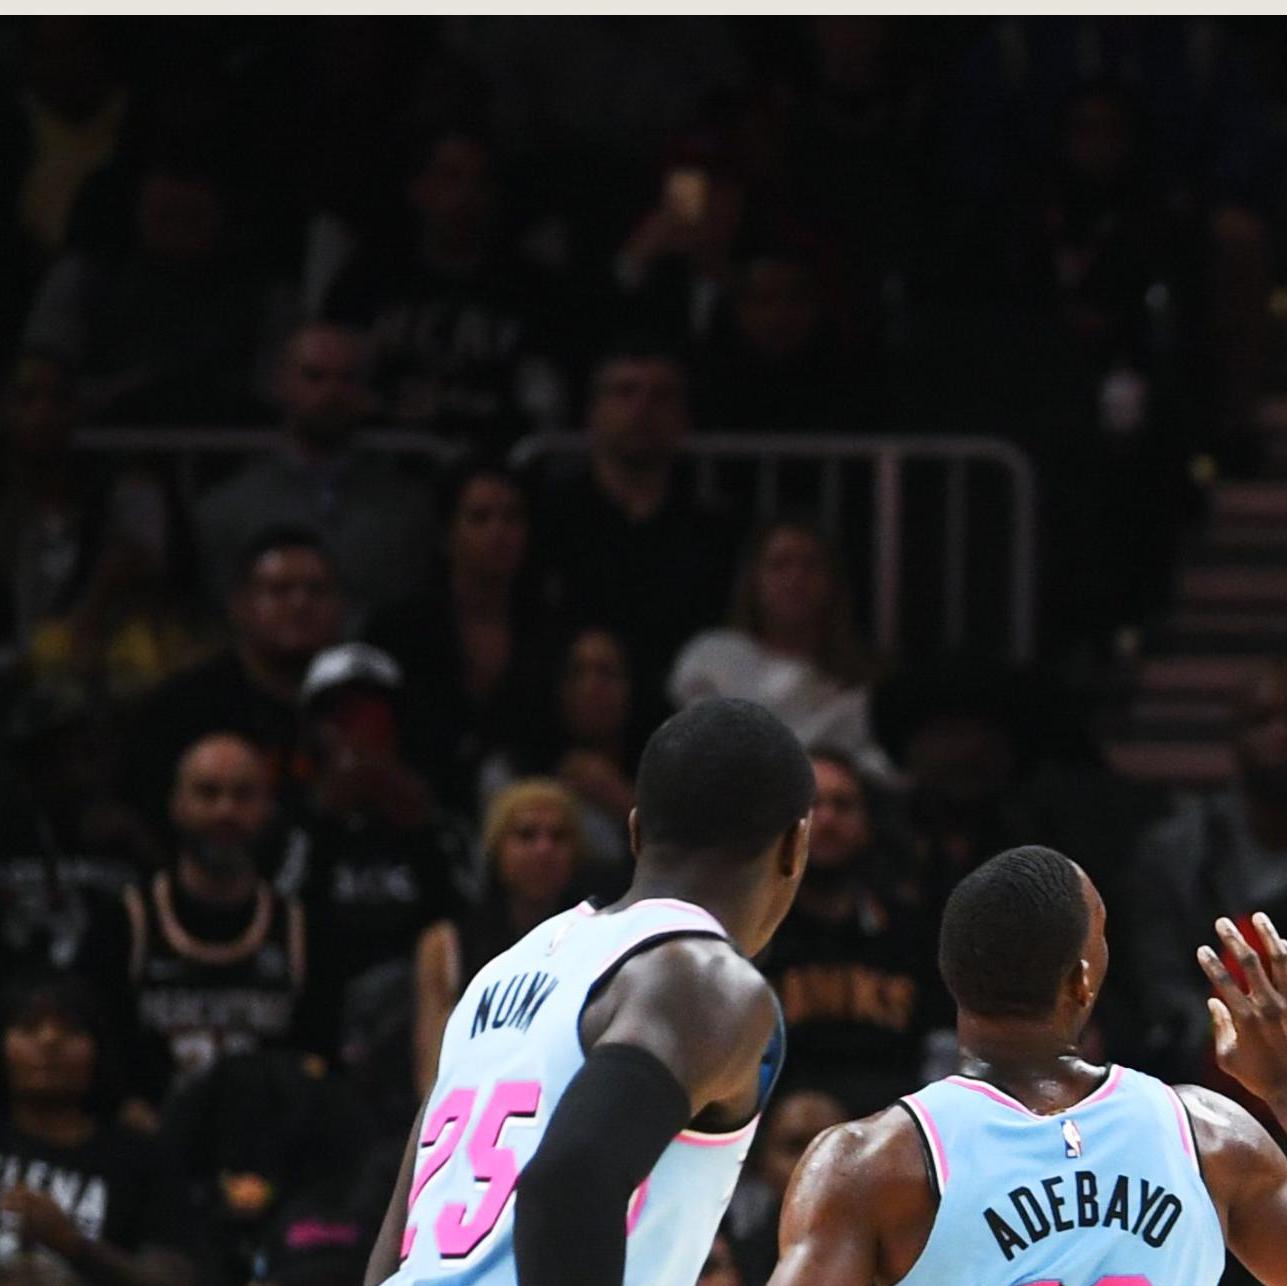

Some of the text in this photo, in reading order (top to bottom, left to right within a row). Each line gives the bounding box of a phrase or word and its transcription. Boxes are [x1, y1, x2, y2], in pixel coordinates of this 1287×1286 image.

[470, 971, 561, 1040] NUNN
[400, 1079, 543, 1267] 25
[982, 1170, 1183, 1262] ADEBAYO
